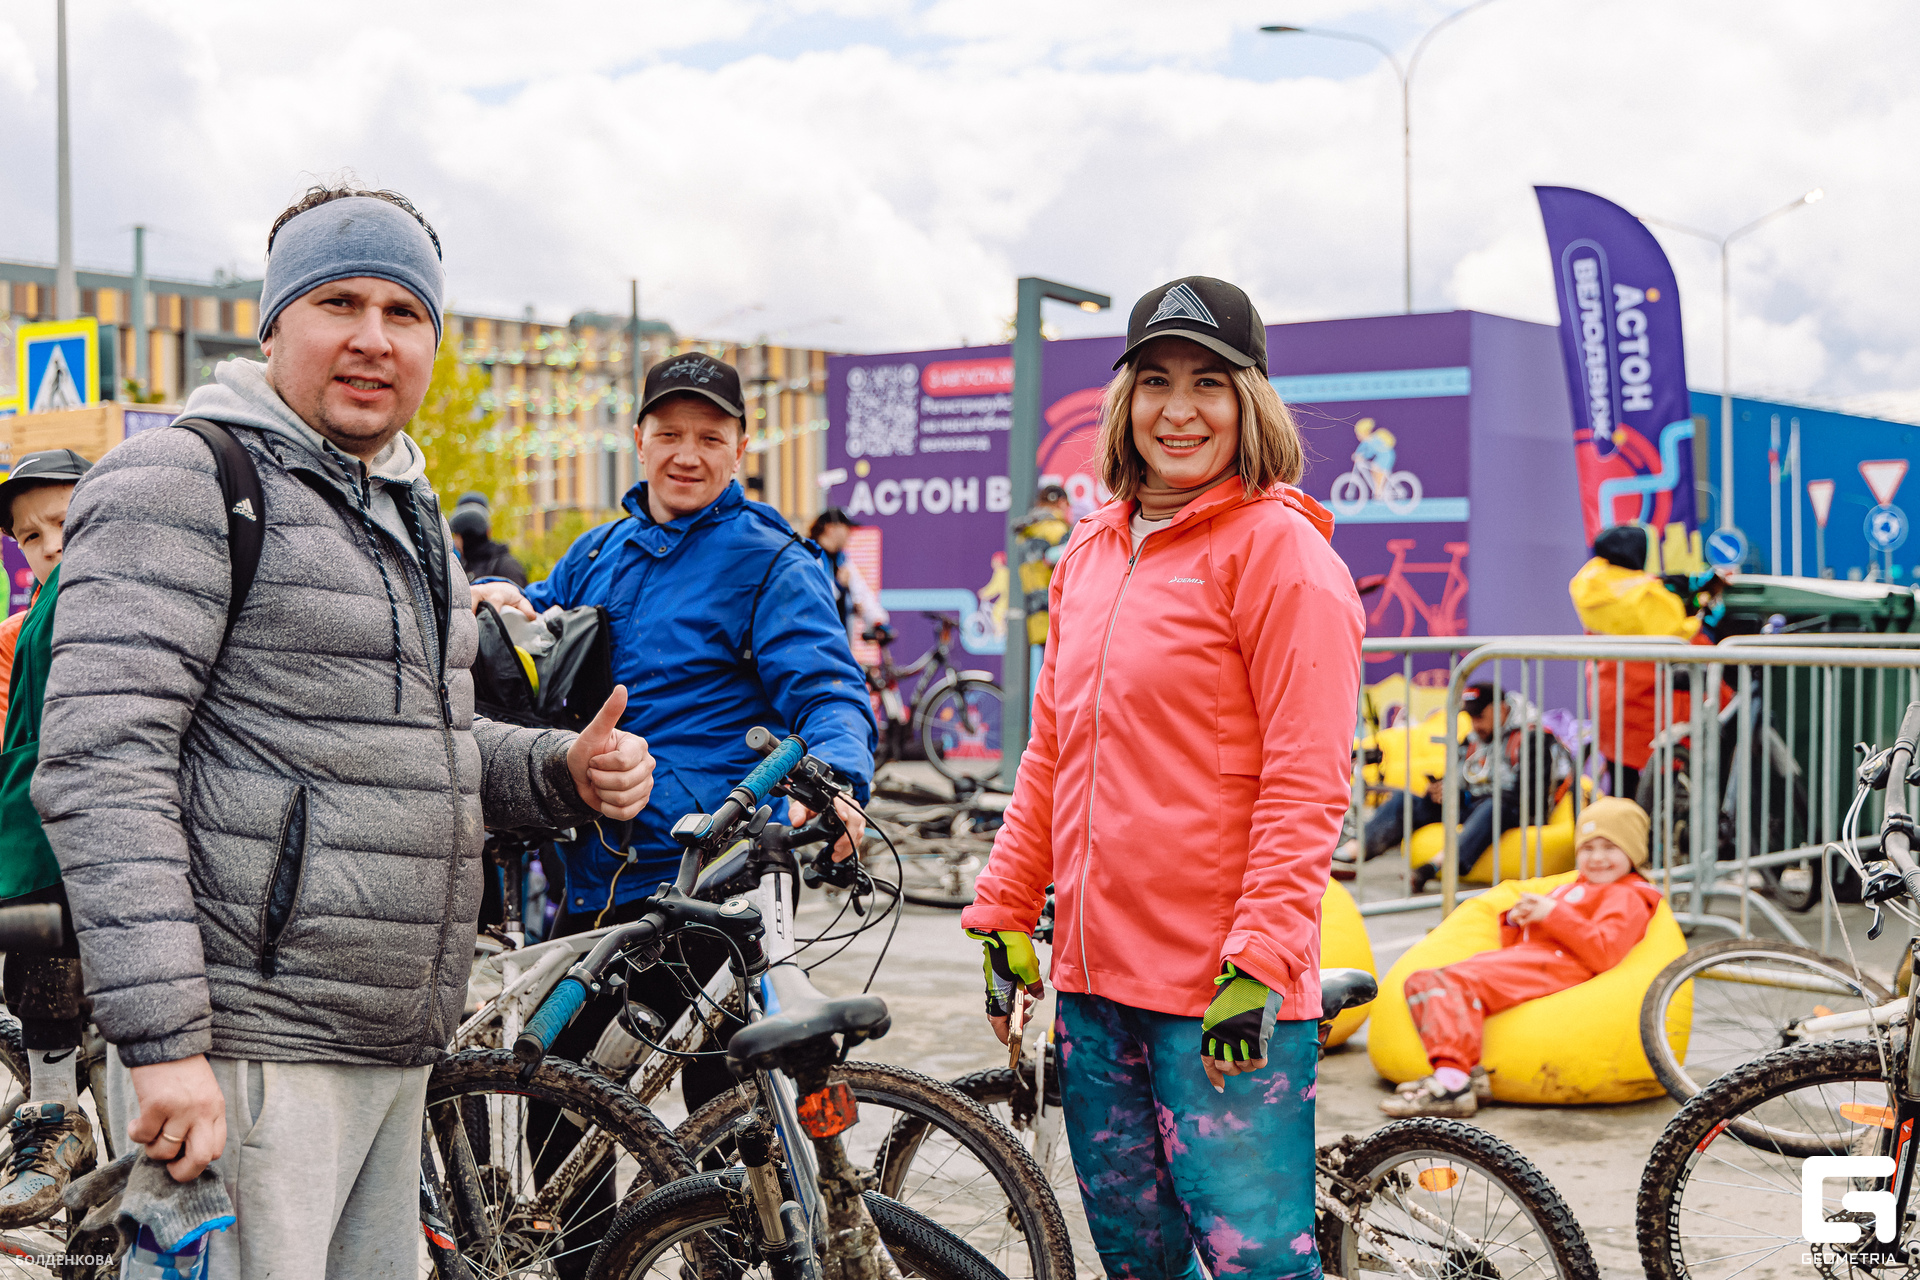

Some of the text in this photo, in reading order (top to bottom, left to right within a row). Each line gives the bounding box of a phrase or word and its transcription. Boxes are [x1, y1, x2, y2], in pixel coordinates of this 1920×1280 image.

[1573, 257, 1611, 440] ВЕЛОДВИЖ
[1613, 283, 1654, 413] АСТОН
[849, 477, 979, 516] АСТОН
[1175, 577, 1206, 585] DEMIX
